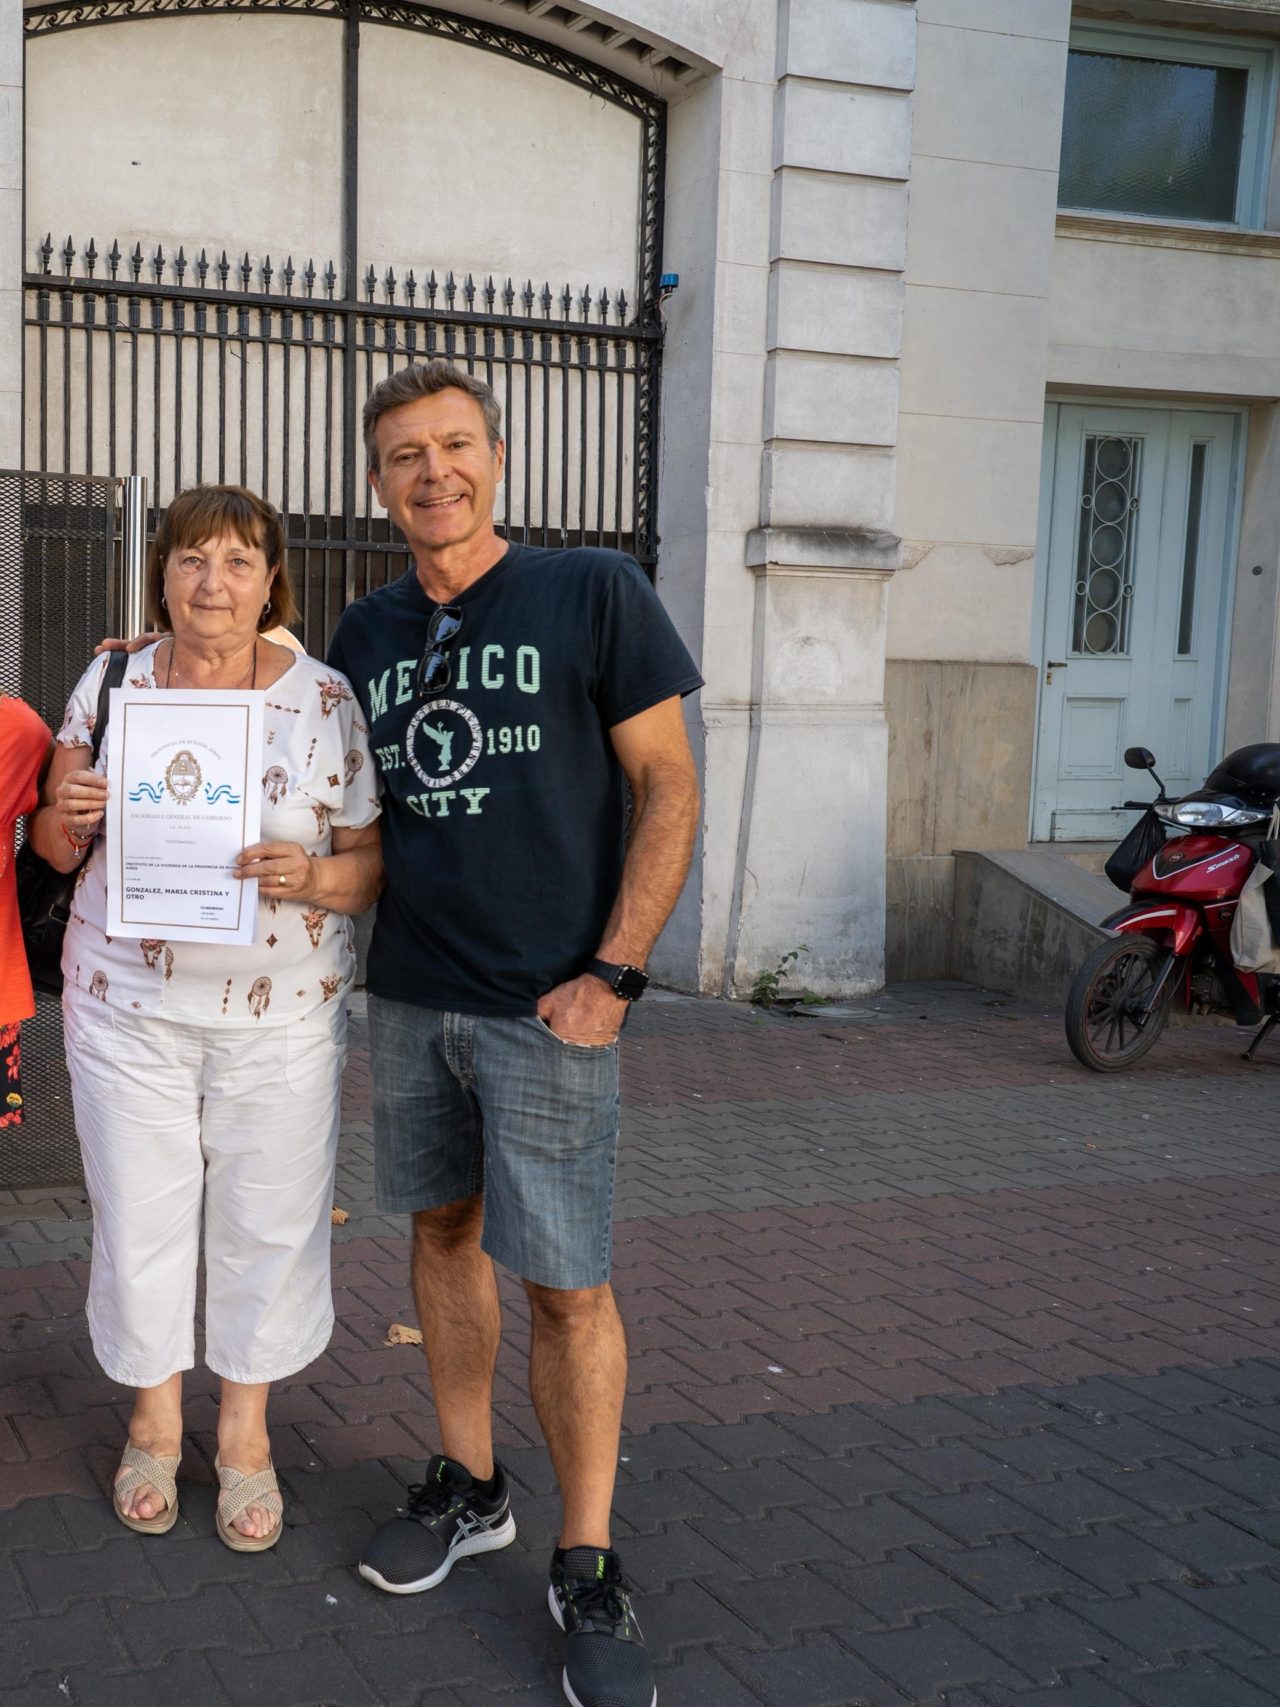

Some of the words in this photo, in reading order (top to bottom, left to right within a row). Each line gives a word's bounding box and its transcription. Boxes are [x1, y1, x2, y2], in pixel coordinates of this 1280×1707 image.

[368, 644, 541, 724] MEICO
[374, 744, 406, 772] EST.
[486, 724, 541, 756] 1910
[406, 787, 491, 818] CITY
[125, 886, 163, 894] GONZALEZ,
[189, 889, 223, 897] CRISTINA
